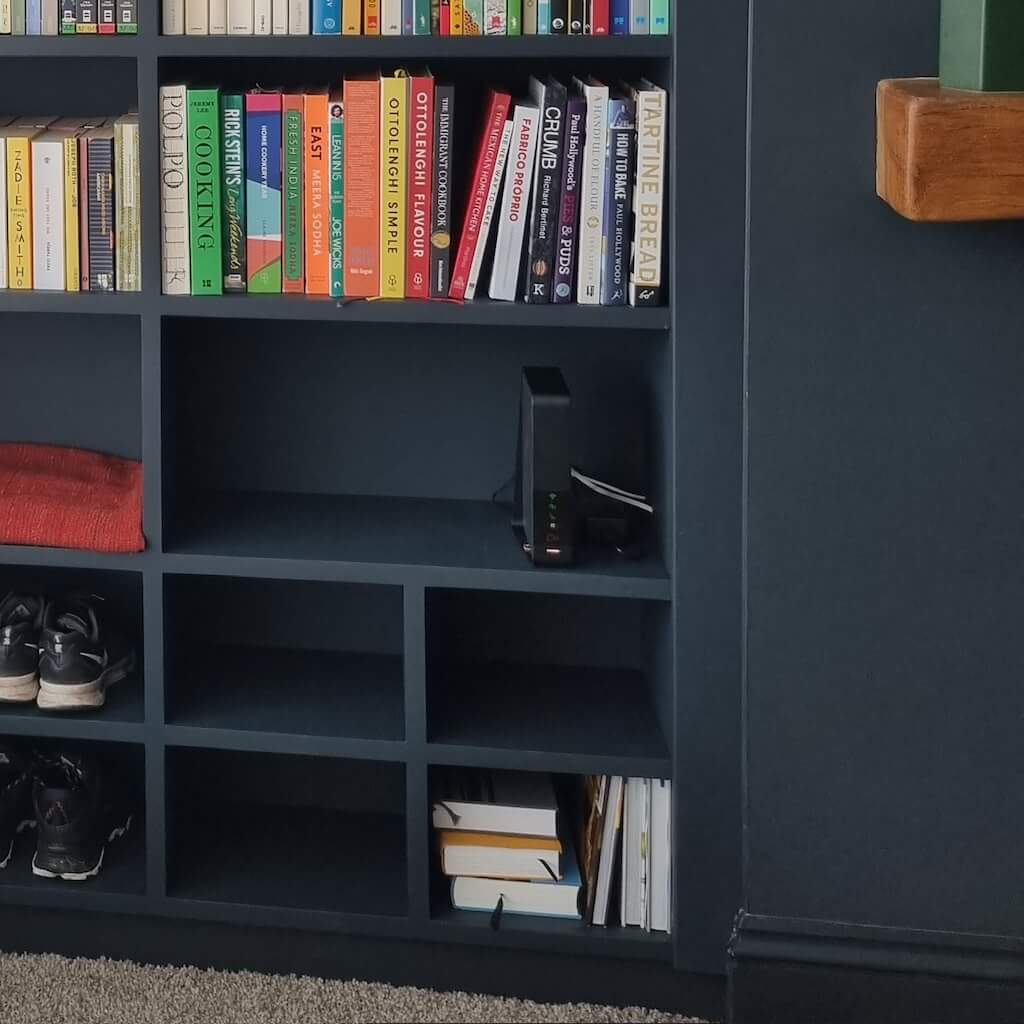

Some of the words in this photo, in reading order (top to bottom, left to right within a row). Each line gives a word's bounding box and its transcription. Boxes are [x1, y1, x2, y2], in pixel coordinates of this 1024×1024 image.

[225, 109, 240, 139] RICK
[288, 116, 297, 154] FRESH
[494, 112, 502, 126] THE
[570, 114, 580, 134] Paul
[592, 105, 602, 156] HANDFUL
[162, 95, 185, 189] POLPO
[311, 126, 321, 160] EAST
[332, 135, 342, 160] LEAN
[389, 98, 399, 193] OTTOLENGHI
[415, 92, 427, 186] OTTOLENGHI
[439, 113, 449, 168] IMMIGRANT
[483, 128, 500, 170] MEXICAN
[517, 118, 532, 170] FABRICO
[542, 106, 560, 170] CRUMB
[616, 133, 628, 156] HOW
[642, 94, 662, 194] TARTINE
[225, 141, 242, 185] STEIN'S
[498, 148, 507, 166] NEW
[566, 136, 578, 191] Hollywood's
[591, 159, 600, 172] OF
[616, 158, 627, 172] TO
[195, 126, 213, 249] COOKING
[288, 161, 297, 199] INDIA
[312, 170, 321, 209] MEERA
[332, 171, 342, 180] 15
[477, 171, 489, 195] HOME
[493, 170, 503, 187] WAY
[541, 175, 552, 205] Richard
[589, 176, 599, 210] FLOUR
[615, 173, 626, 200] BAKE
[437, 171, 447, 226] COOKBOOK
[469, 197, 484, 231] KITCHEN
[490, 191, 498, 202] TO
[563, 194, 574, 223] PIES
[616, 203, 624, 225] PAUL
[229, 214, 242, 269] Weekends
[313, 214, 321, 256] SODHA
[332, 217, 342, 235] JOE
[388, 202, 397, 254] SIMPLE
[413, 193, 424, 257] FLAVOUR
[561, 225, 571, 236] &
[640, 203, 658, 282] BREAD
[332, 235, 342, 269] WICKS
[559, 239, 572, 275] PUDS
[614, 228, 622, 284] HOLLYWOOD
